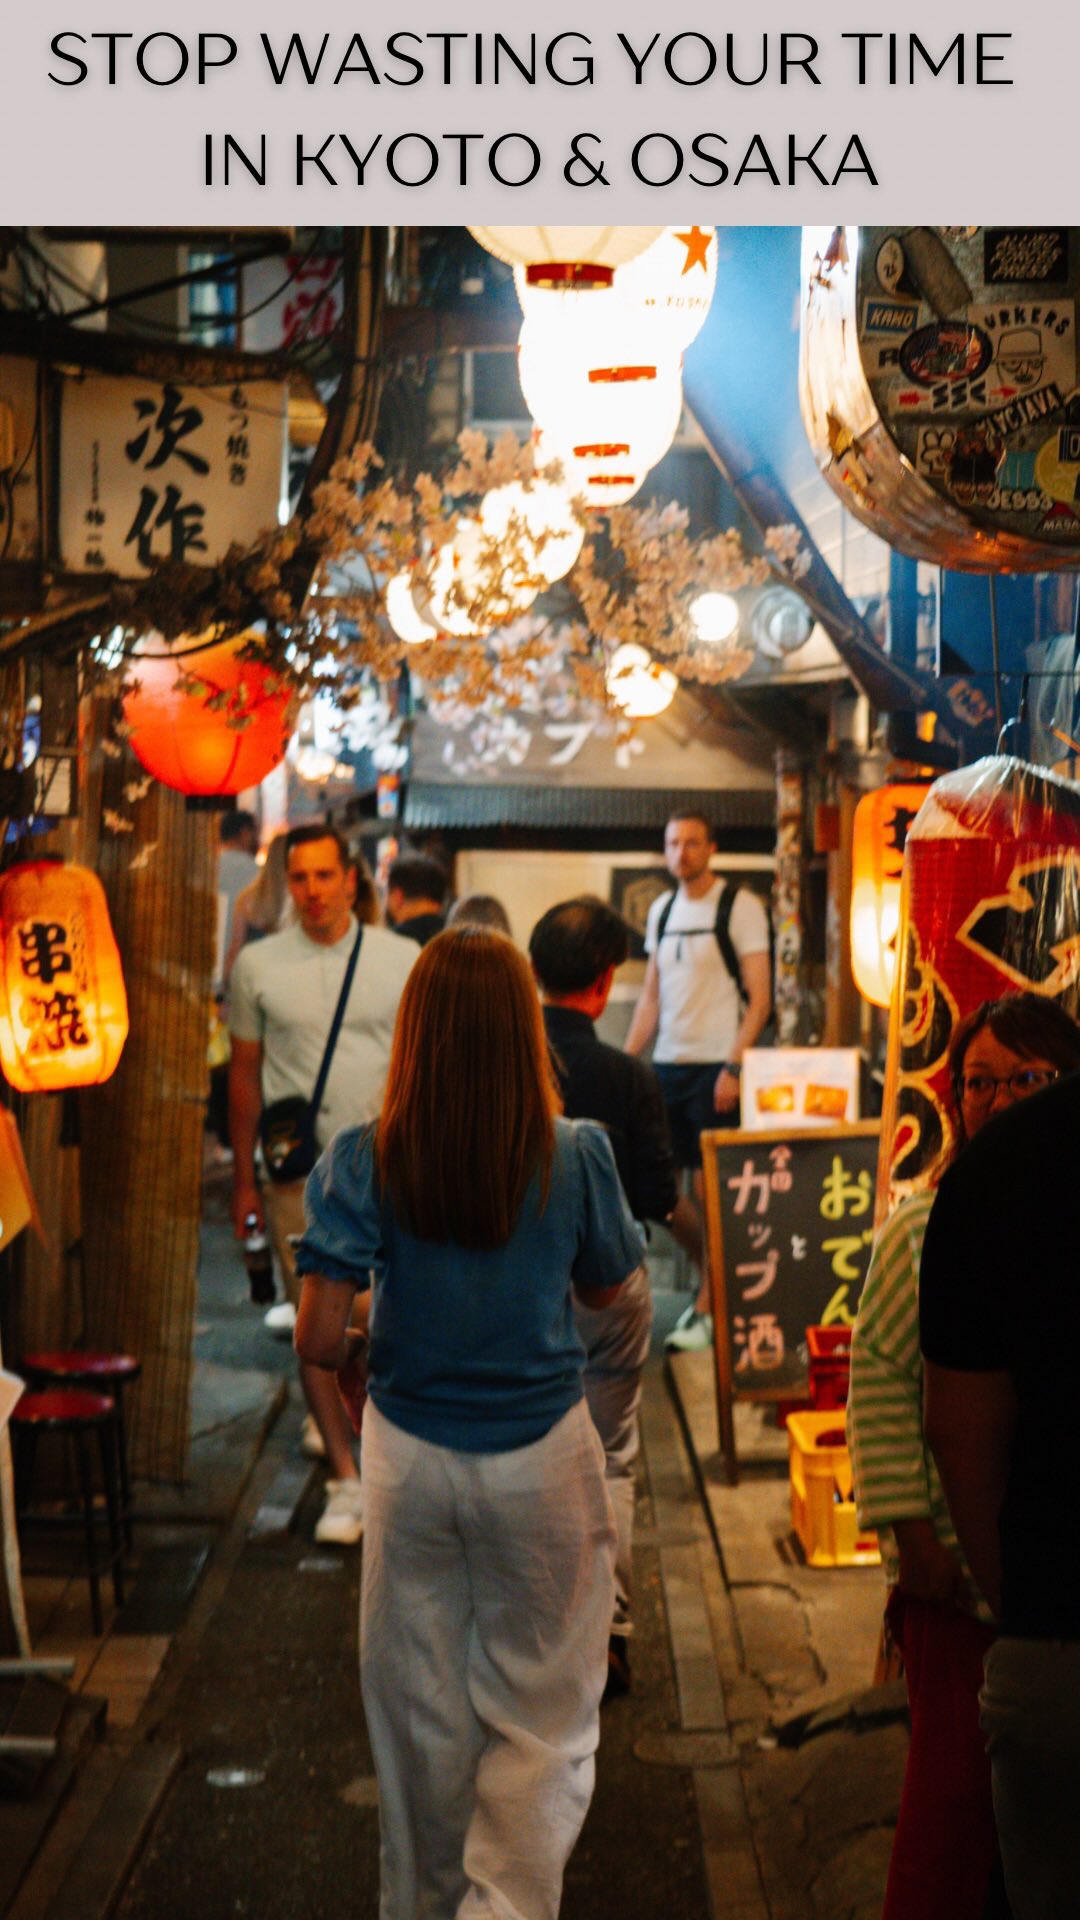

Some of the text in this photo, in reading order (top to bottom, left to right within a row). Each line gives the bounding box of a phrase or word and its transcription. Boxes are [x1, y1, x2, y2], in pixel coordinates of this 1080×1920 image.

[124, 382, 210, 568] 次作
[819, 1155, 874, 1327] おでん
